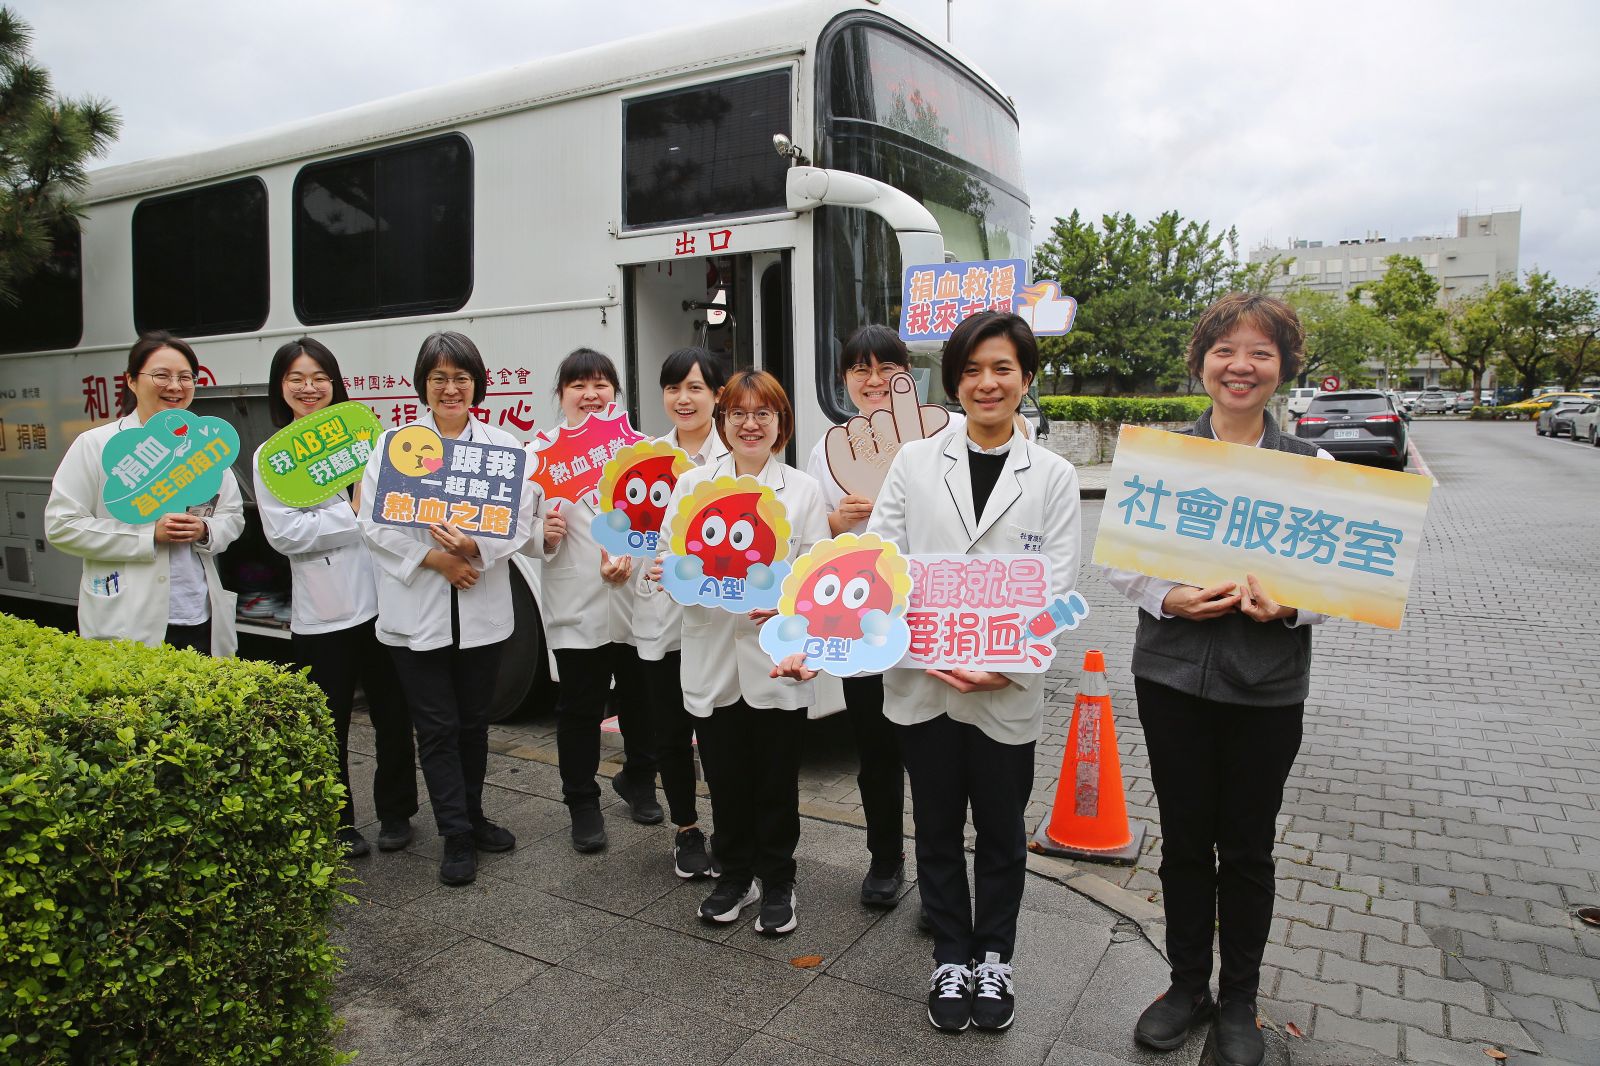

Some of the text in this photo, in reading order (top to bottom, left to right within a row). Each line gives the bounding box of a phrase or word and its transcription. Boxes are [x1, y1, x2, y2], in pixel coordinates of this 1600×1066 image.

[675, 229, 732, 256] 出口
[910, 265, 1015, 303] 捐血救援
[111, 435, 171, 490] 捐血
[267, 415, 352, 476] 我AB型
[450, 444, 517, 480] 跟我
[420, 474, 513, 503] 一起踏上
[382, 491, 513, 536] 熱血之路
[1117, 474, 1404, 577] 社會服務室
[698, 577, 745, 600] A型
[802, 639, 851, 663] B型
[907, 612, 1022, 658] 要捐血
